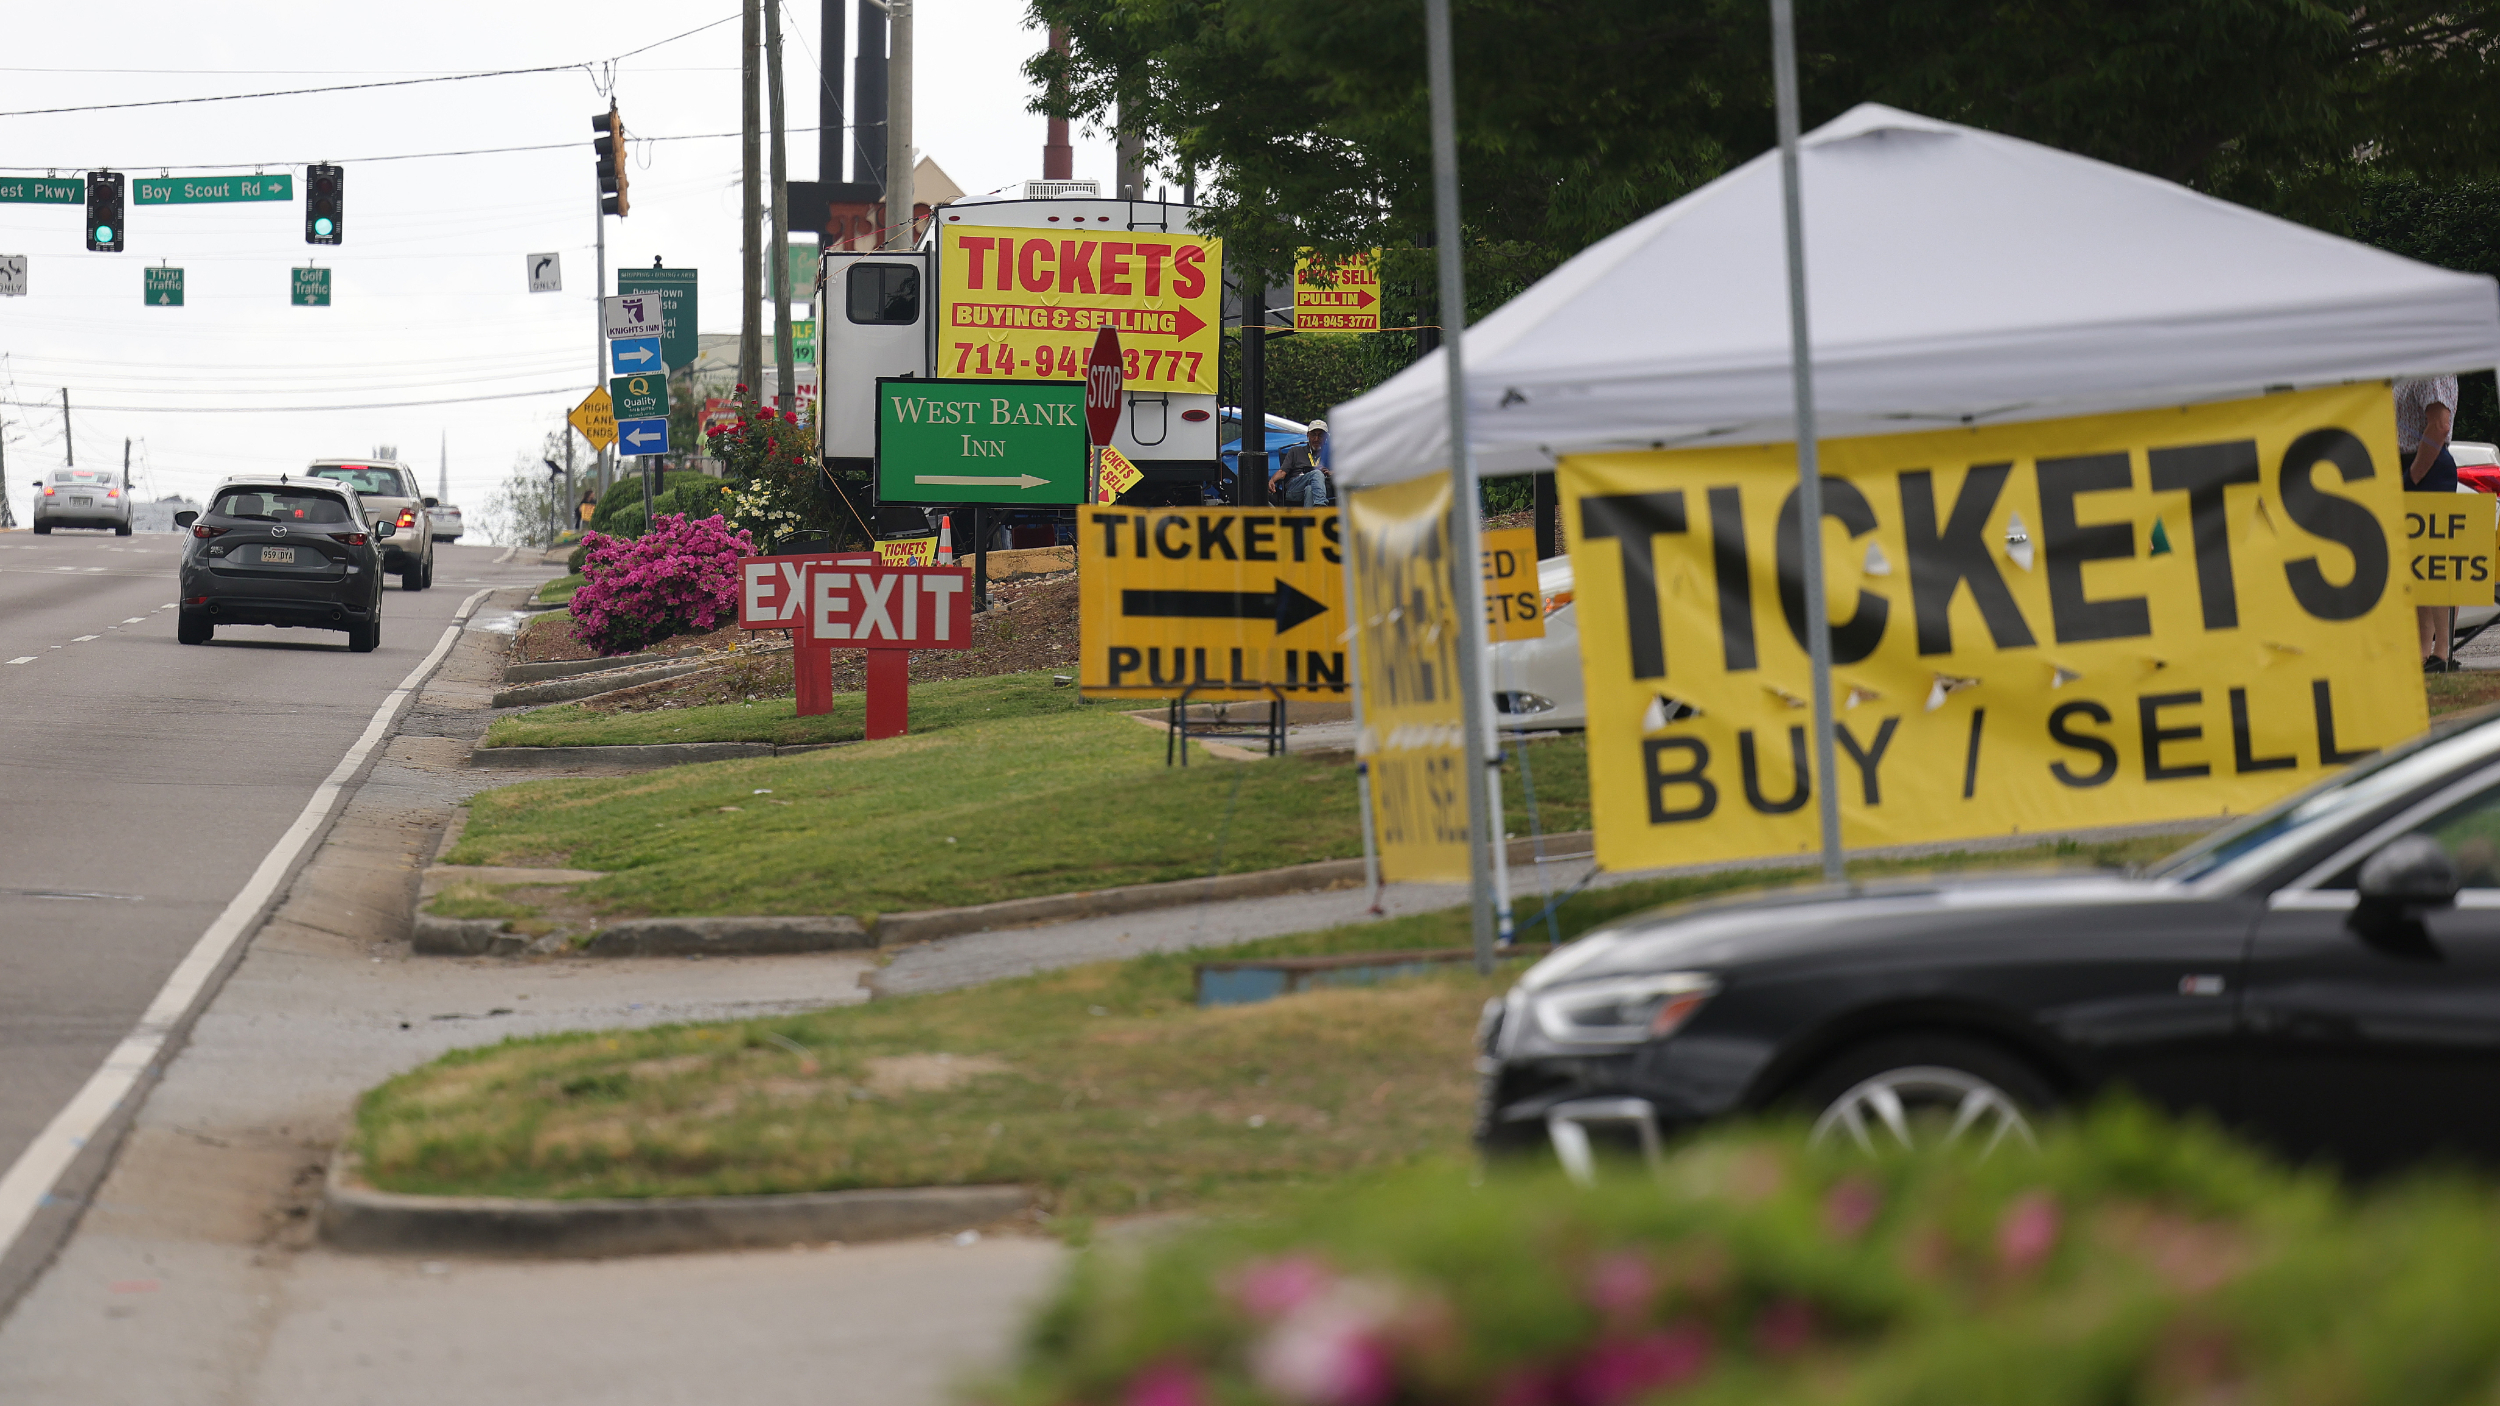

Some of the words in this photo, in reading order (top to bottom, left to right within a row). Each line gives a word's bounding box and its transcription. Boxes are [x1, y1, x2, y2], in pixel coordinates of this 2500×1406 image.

[0, 184, 24, 198] est
[34, 184, 75, 202] Pkwy
[142, 185, 172, 203] Boy
[184, 183, 230, 199] Scout
[241, 181, 261, 197] Rd
[150, 269, 179, 281] Thru
[300, 270, 323, 283] Golf
[959, 236, 1206, 299] TICKETS
[1342, 269, 1376, 285] SELL
[147, 279, 182, 291] Traffic
[294, 281, 328, 295] Traffic
[533, 280, 557, 290] ONLY
[1300, 293, 1339, 305] PULL
[1342, 293, 1358, 305] IN
[957, 305, 1048, 328] BUYING
[1051, 312, 1071, 328] &
[1075, 312, 1176, 333] SELLING
[1299, 315, 1374, 328] 714-945-3777
[609, 325, 643, 335] KNIGHTS
[645, 324, 660, 332] INN
[629, 377, 650, 396] Q
[1088, 364, 1121, 409] STOP
[623, 397, 657, 409] Quality
[585, 415, 614, 426] LANE
[586, 427, 614, 438] ENDS
[1101, 447, 1135, 480] ICKETS
[2406, 512, 2467, 540] OLF
[1092, 513, 1341, 565] TICKETS
[263, 550, 277, 559] 959
[885, 541, 927, 557] TICKETS
[1580, 427, 2390, 681] TICKETS
[1482, 550, 1515, 579] ED
[2411, 555, 2488, 582] KETS
[745, 559, 872, 622] EX
[813, 573, 964, 641] EXIT
[1485, 592, 1537, 622] ETS
[1108, 646, 1261, 688] PULL
[1285, 648, 1344, 693] IN
[1642, 717, 1900, 825] BUY
[1963, 707, 1985, 799] /
[2048, 680, 2382, 788] SELL
